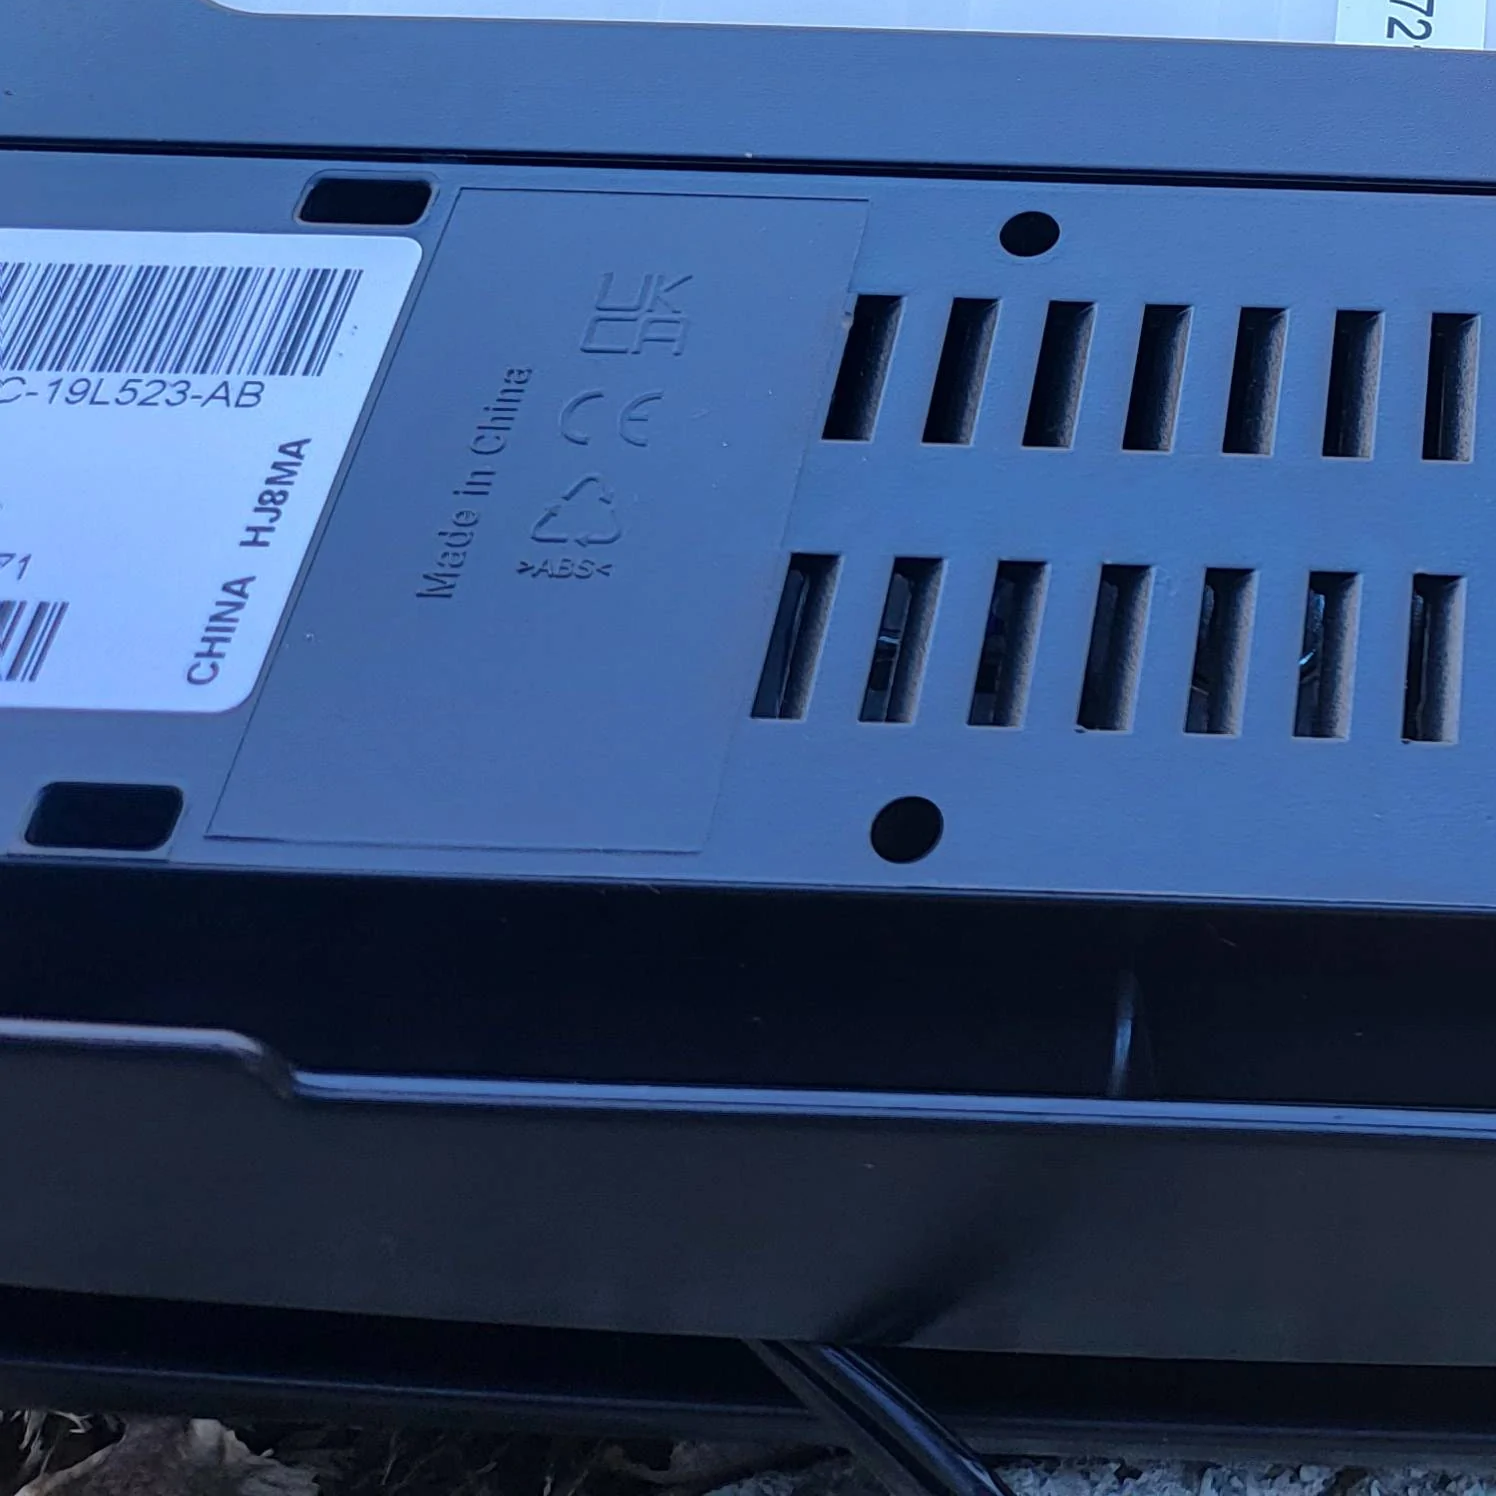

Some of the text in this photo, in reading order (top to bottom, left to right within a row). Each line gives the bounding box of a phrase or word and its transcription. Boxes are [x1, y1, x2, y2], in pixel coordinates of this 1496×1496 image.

[0, 376, 266, 409] C-19L523-AB
[415, 368, 533, 599] Made in China
[186, 437, 312, 687] CHINA HJ8MA
